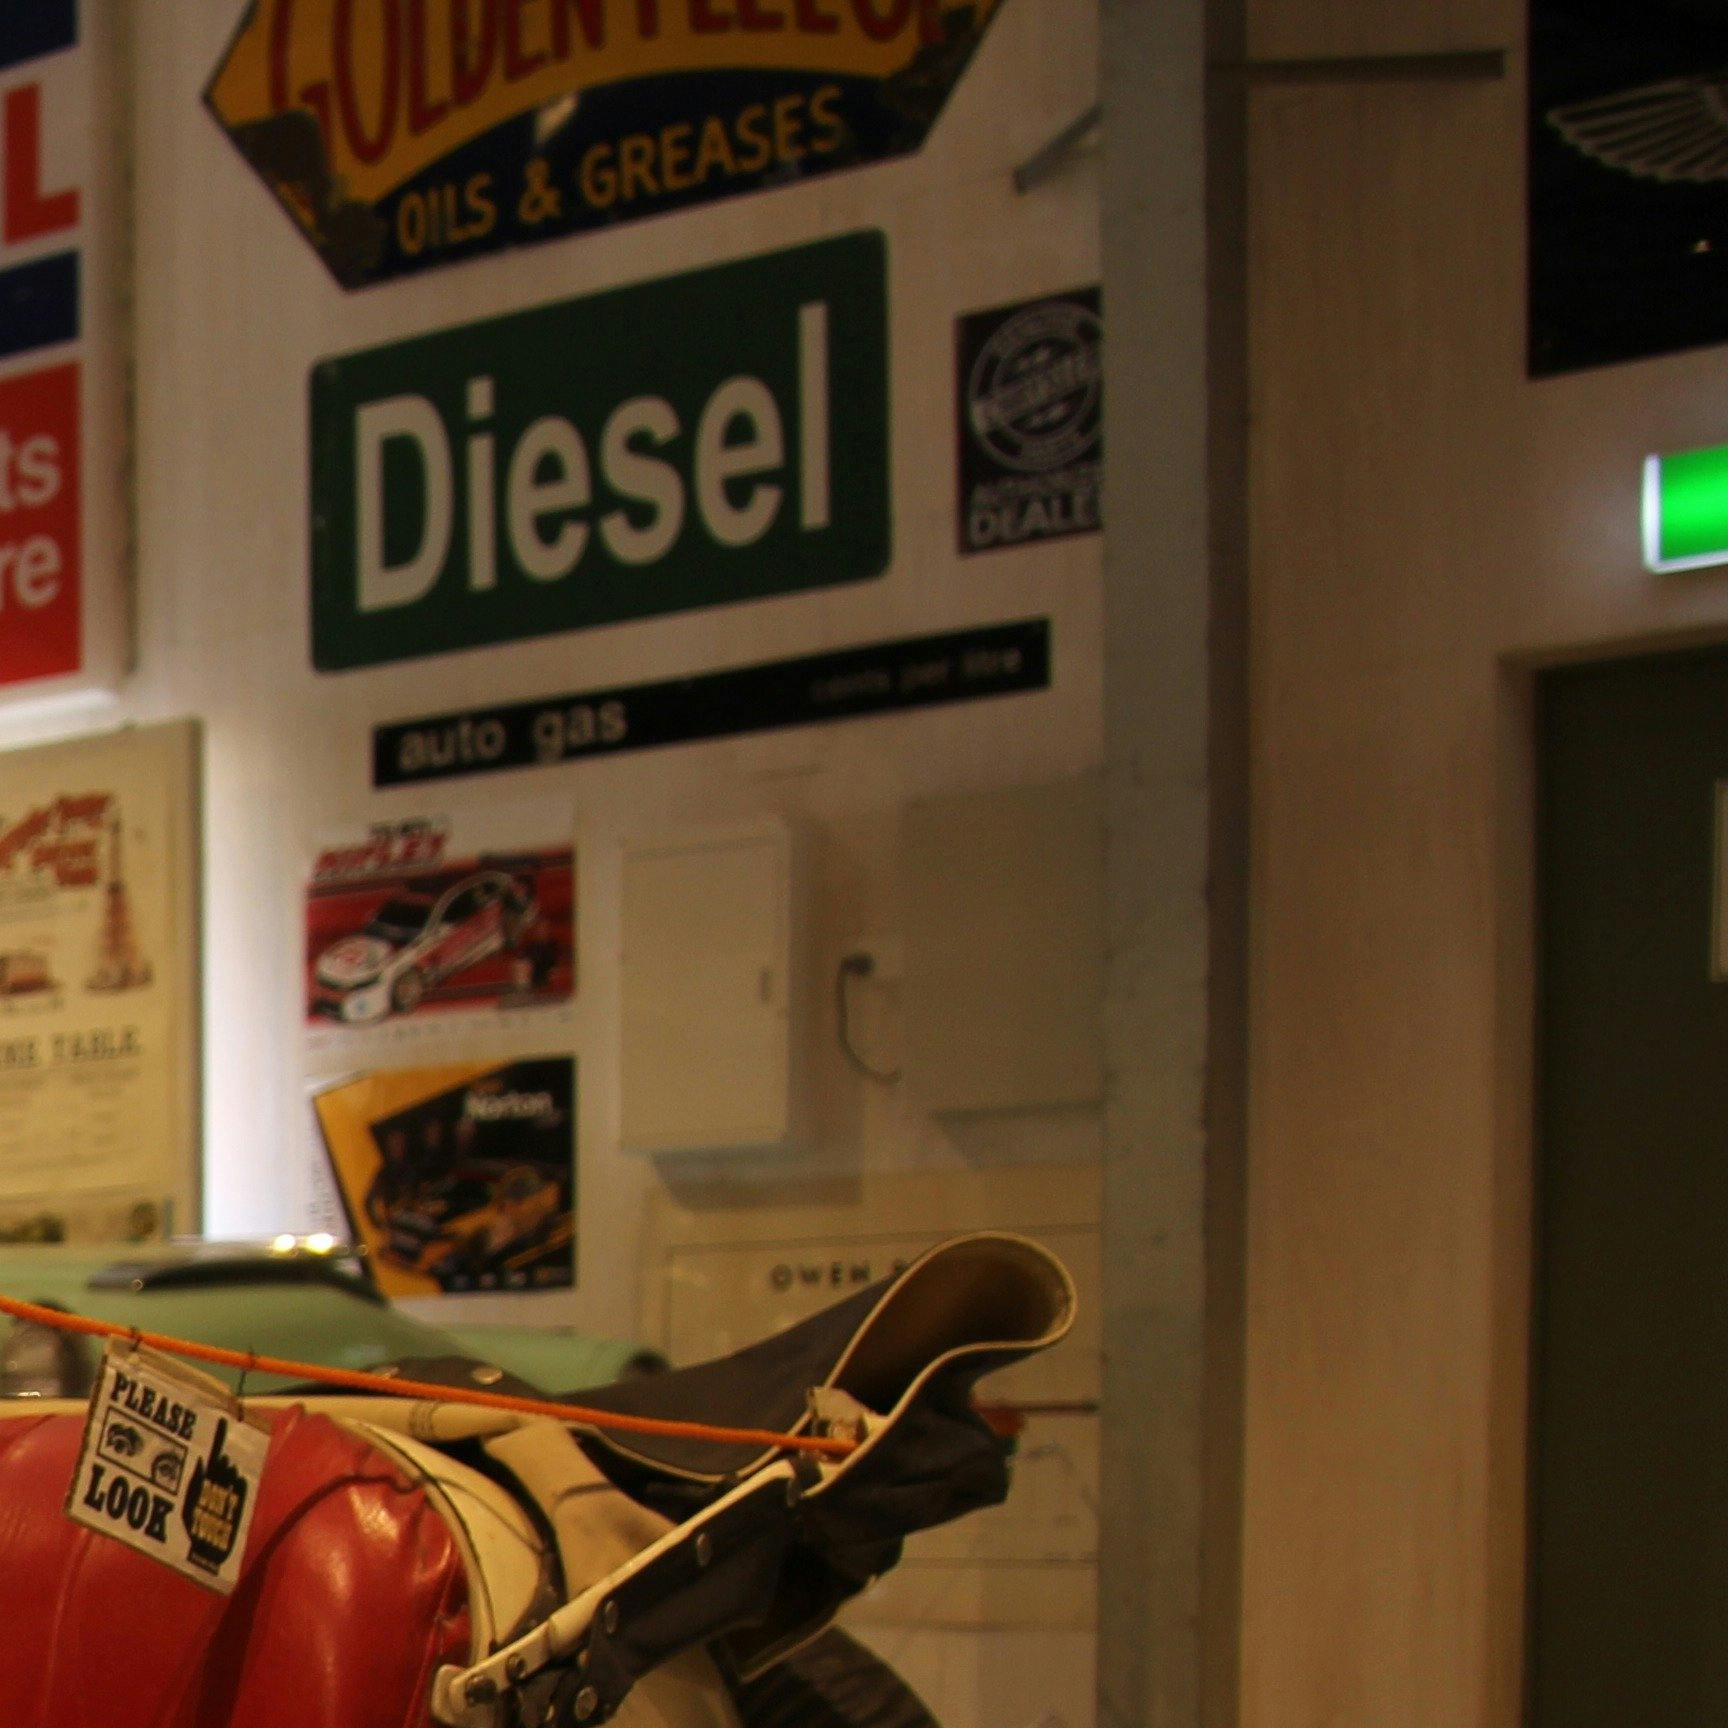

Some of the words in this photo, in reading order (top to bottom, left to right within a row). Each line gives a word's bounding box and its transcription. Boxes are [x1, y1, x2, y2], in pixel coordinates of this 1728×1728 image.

[268, 0, 601, 164] GOLD
[396, 175, 498, 256] OILS
[517, 156, 562, 223] &
[576, 84, 846, 208] GREASES
[354, 300, 832, 612] Diesel
[968, 487, 1102, 546] DEALE
[399, 722, 506, 771] auto
[531, 700, 629, 761] gas
[111, 1371, 198, 1441] PLEASE
[83, 1464, 175, 1544] LOOK
